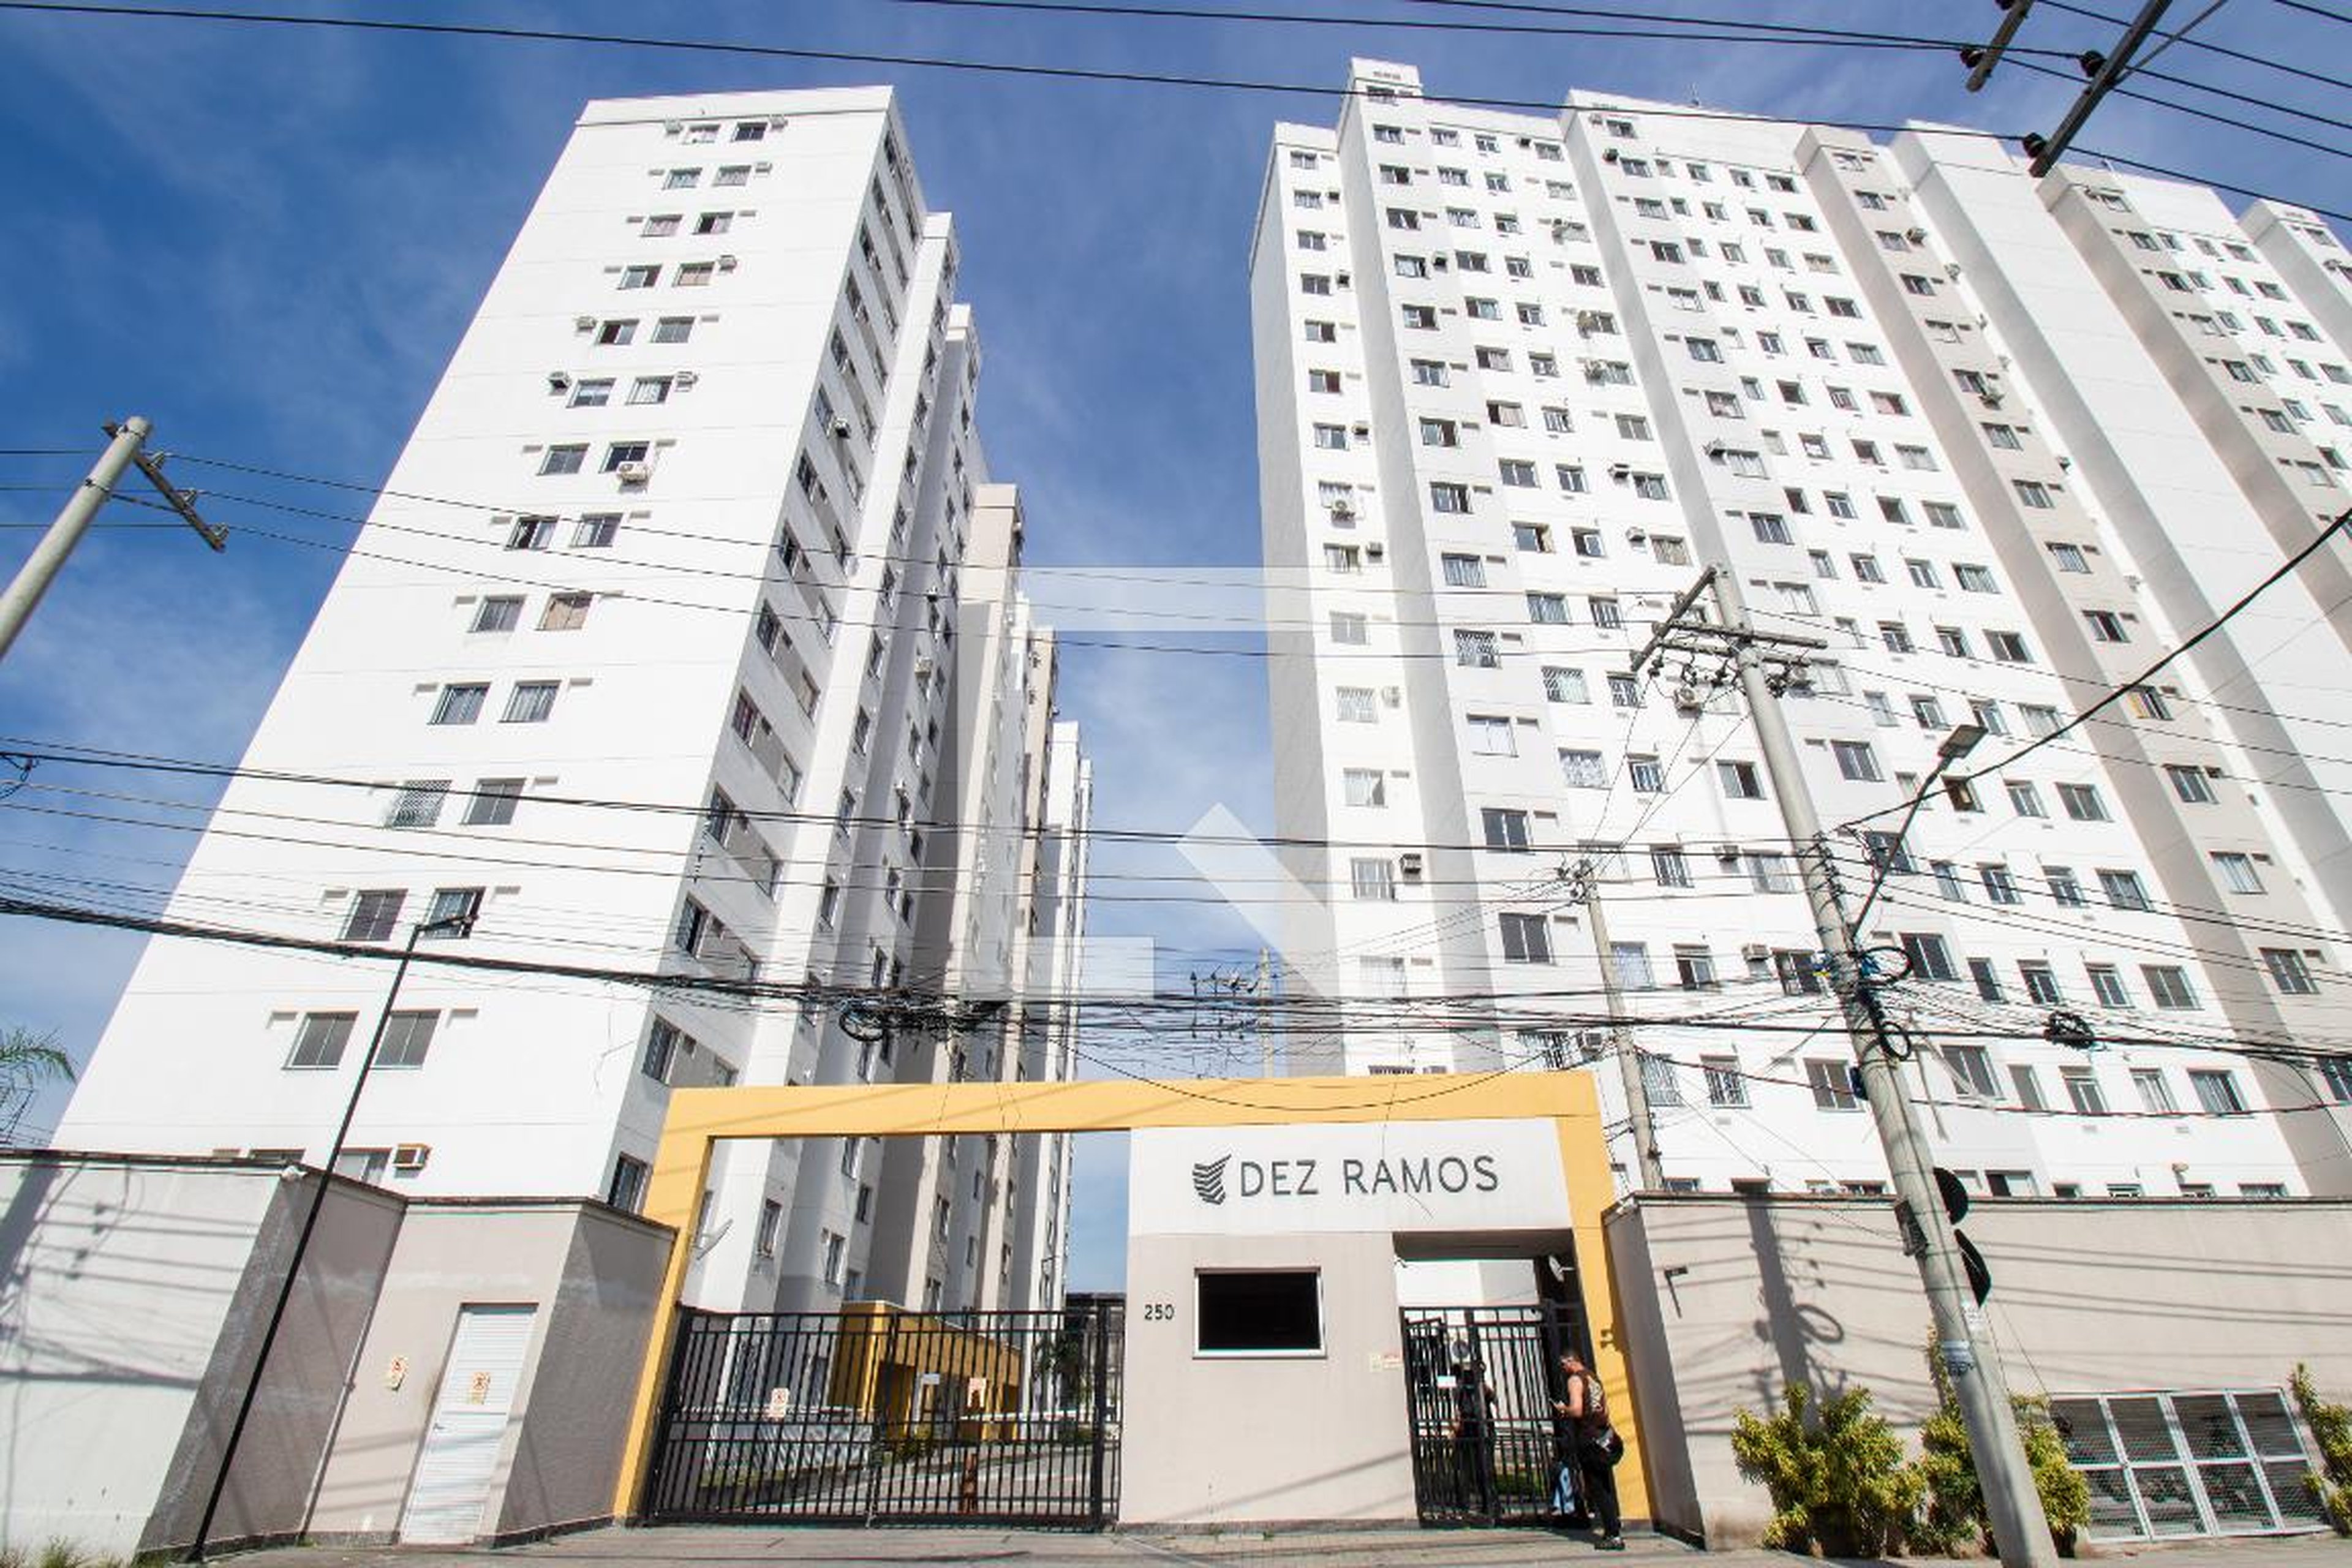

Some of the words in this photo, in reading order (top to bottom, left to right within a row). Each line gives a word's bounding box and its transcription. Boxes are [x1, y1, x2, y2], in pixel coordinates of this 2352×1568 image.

[1240, 1159, 1319, 1197] DEZ
[1343, 1155, 1499, 1194] RAMOS
[1144, 1303, 1175, 1321] 250
